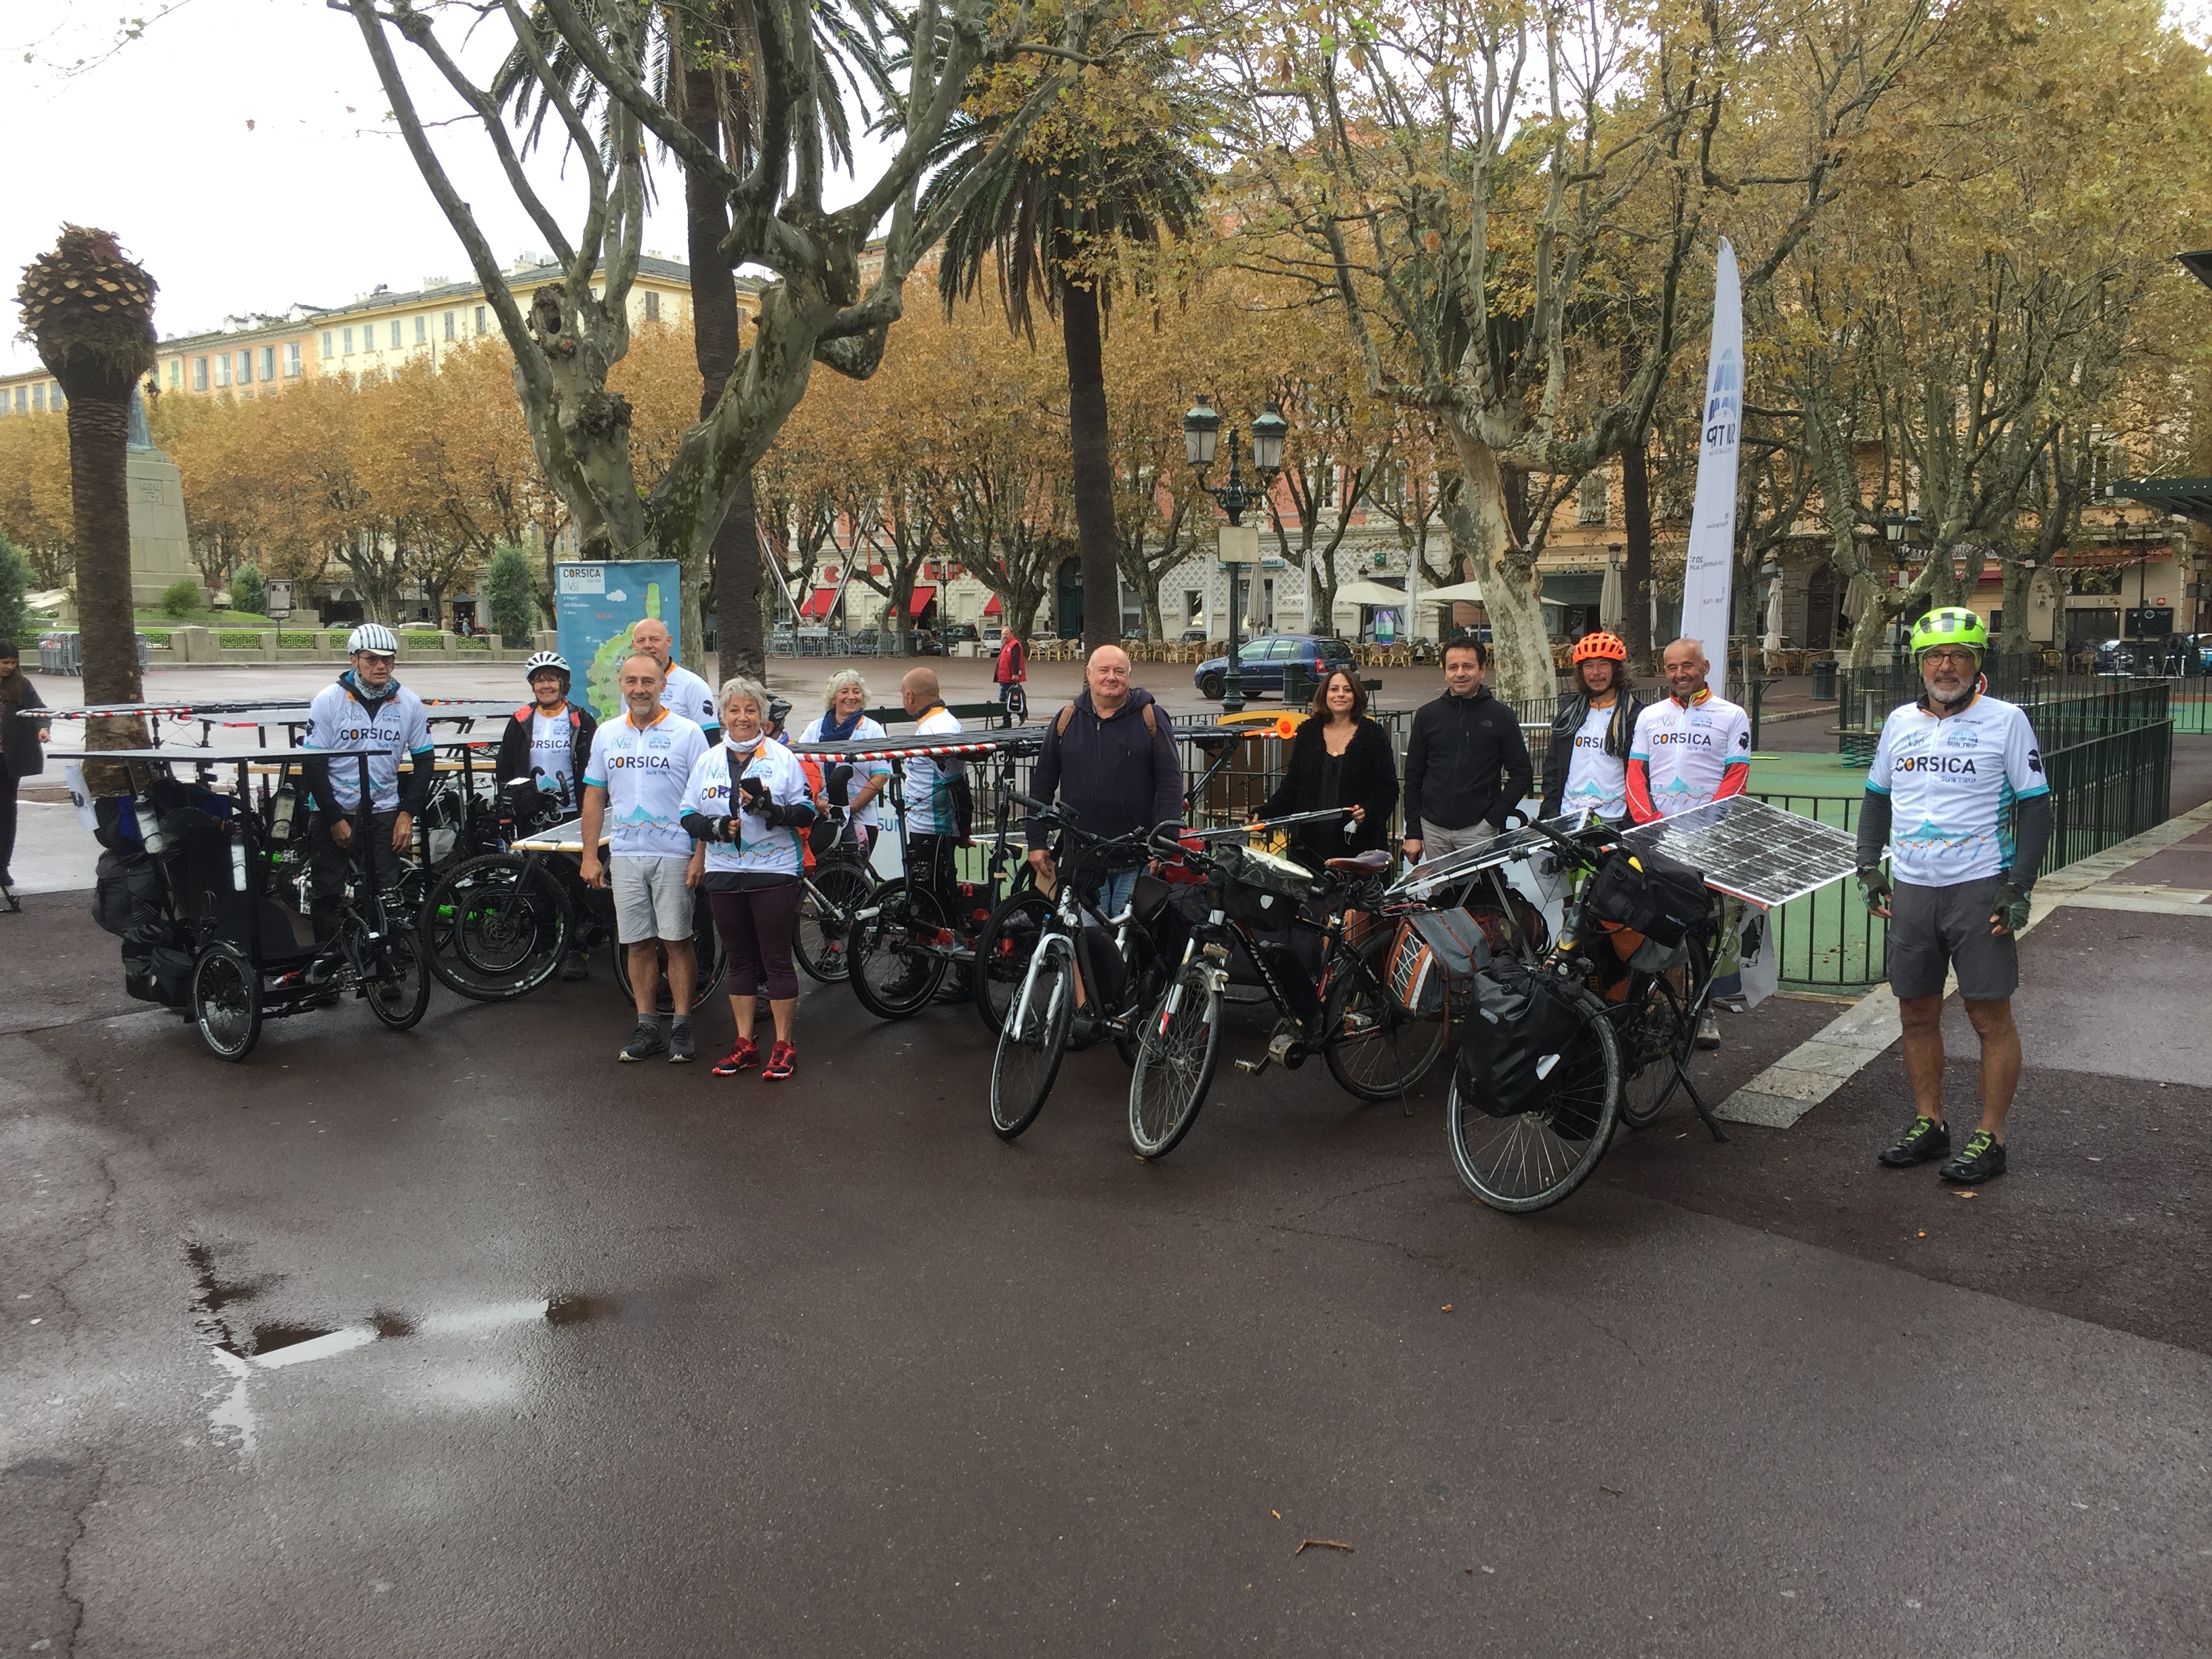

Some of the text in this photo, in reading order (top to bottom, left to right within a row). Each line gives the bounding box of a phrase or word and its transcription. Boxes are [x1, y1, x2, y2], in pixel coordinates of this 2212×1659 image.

[563, 569, 601, 578] CORSICA
[340, 728, 401, 742] CORSICA
[1653, 733, 1711, 746] CORSICA
[608, 756, 670, 770] CORSICA
[1895, 756, 1976, 774] CORSICA
